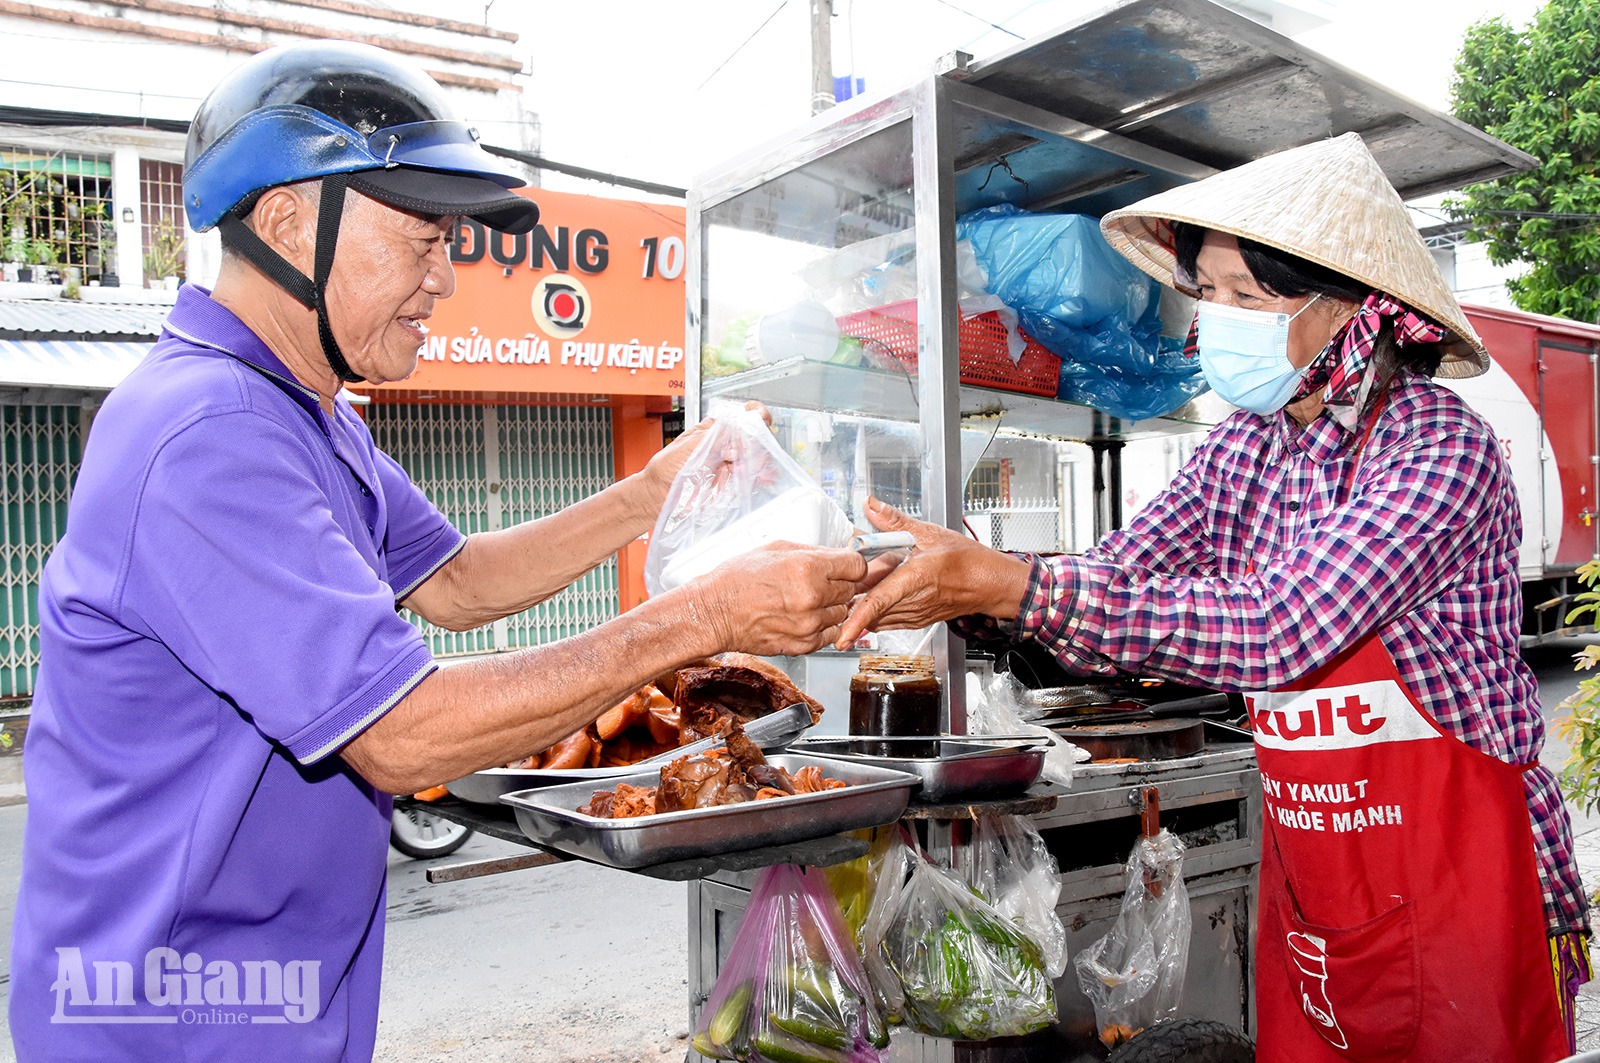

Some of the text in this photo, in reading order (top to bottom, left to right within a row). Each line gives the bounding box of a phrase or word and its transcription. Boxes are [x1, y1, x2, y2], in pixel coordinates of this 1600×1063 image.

[450, 326, 494, 363] SỬA
[495, 332, 551, 364] CHỮA
[560, 341, 606, 373] PHỤ
[606, 337, 655, 375] KIỆN
[656, 340, 684, 369] ÉP
[1245, 694, 1387, 741] kult
[1286, 778, 1369, 803] YAKULT
[1276, 805, 1326, 831] KHỎE
[1331, 804, 1403, 833] MẠNH
